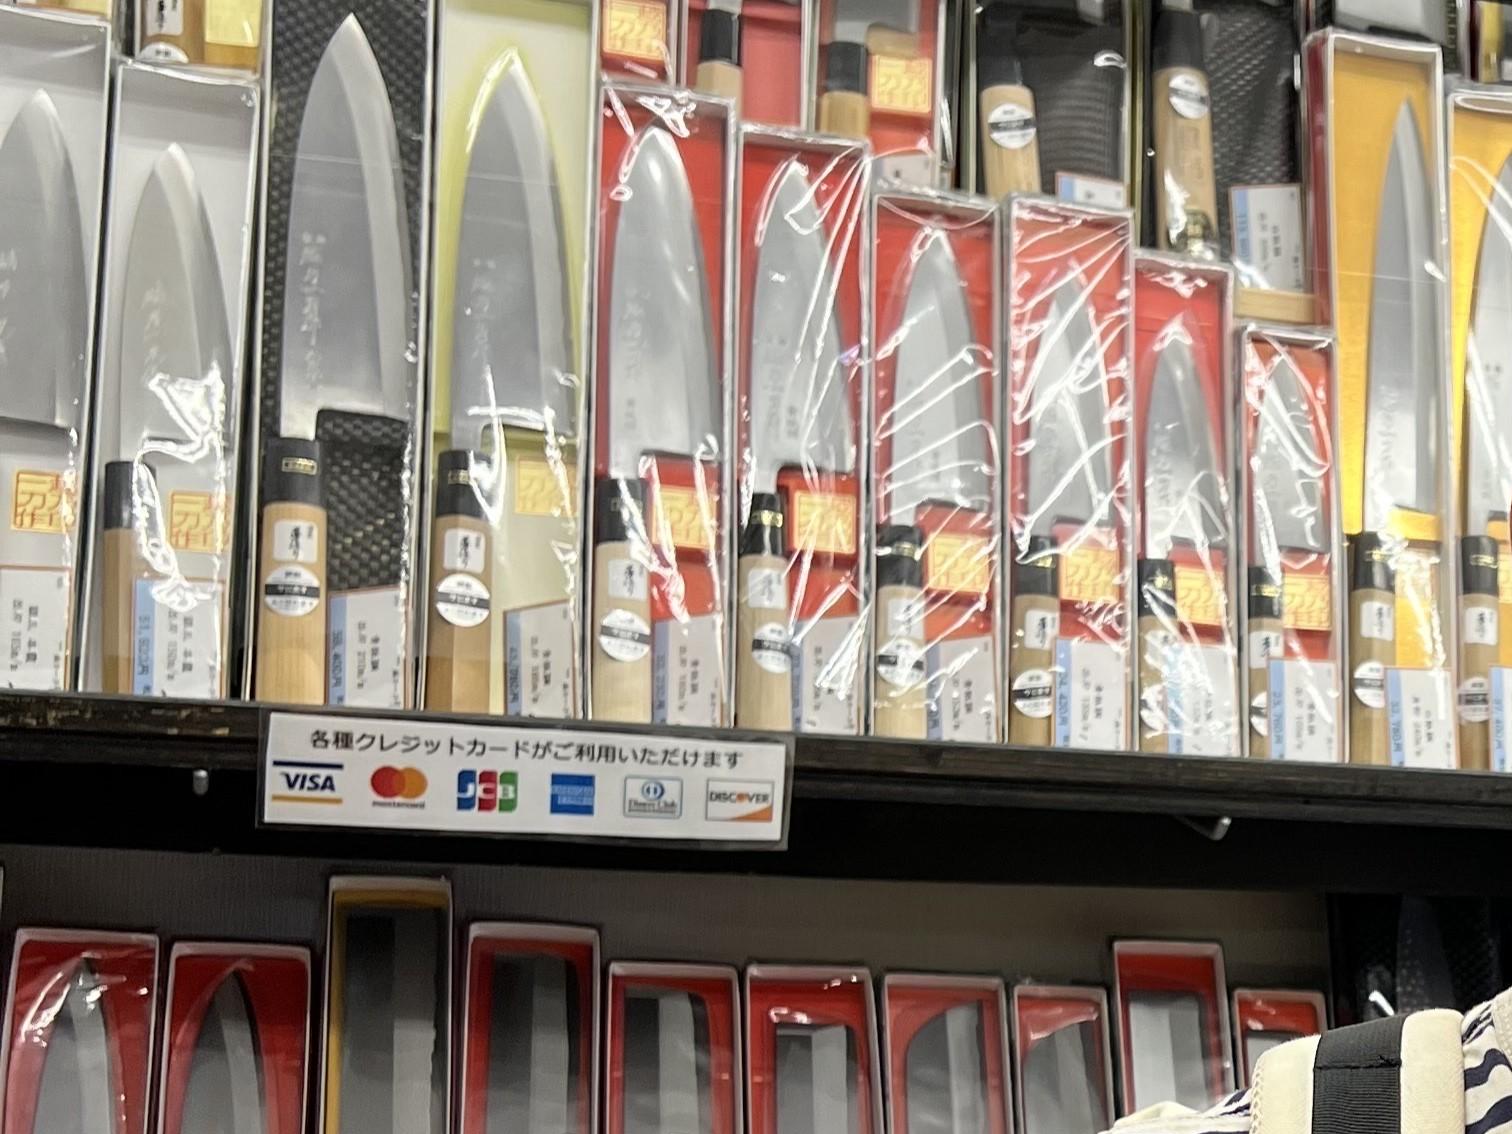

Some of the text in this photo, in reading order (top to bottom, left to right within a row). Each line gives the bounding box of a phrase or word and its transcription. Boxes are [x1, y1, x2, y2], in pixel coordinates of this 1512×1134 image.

[310, 729, 744, 769] 各種クレジットカードがご利用いただけます
[284, 771, 336, 793] VISA
[371, 800, 426, 810] mastercard
[709, 790, 770, 804] DISCOVER
